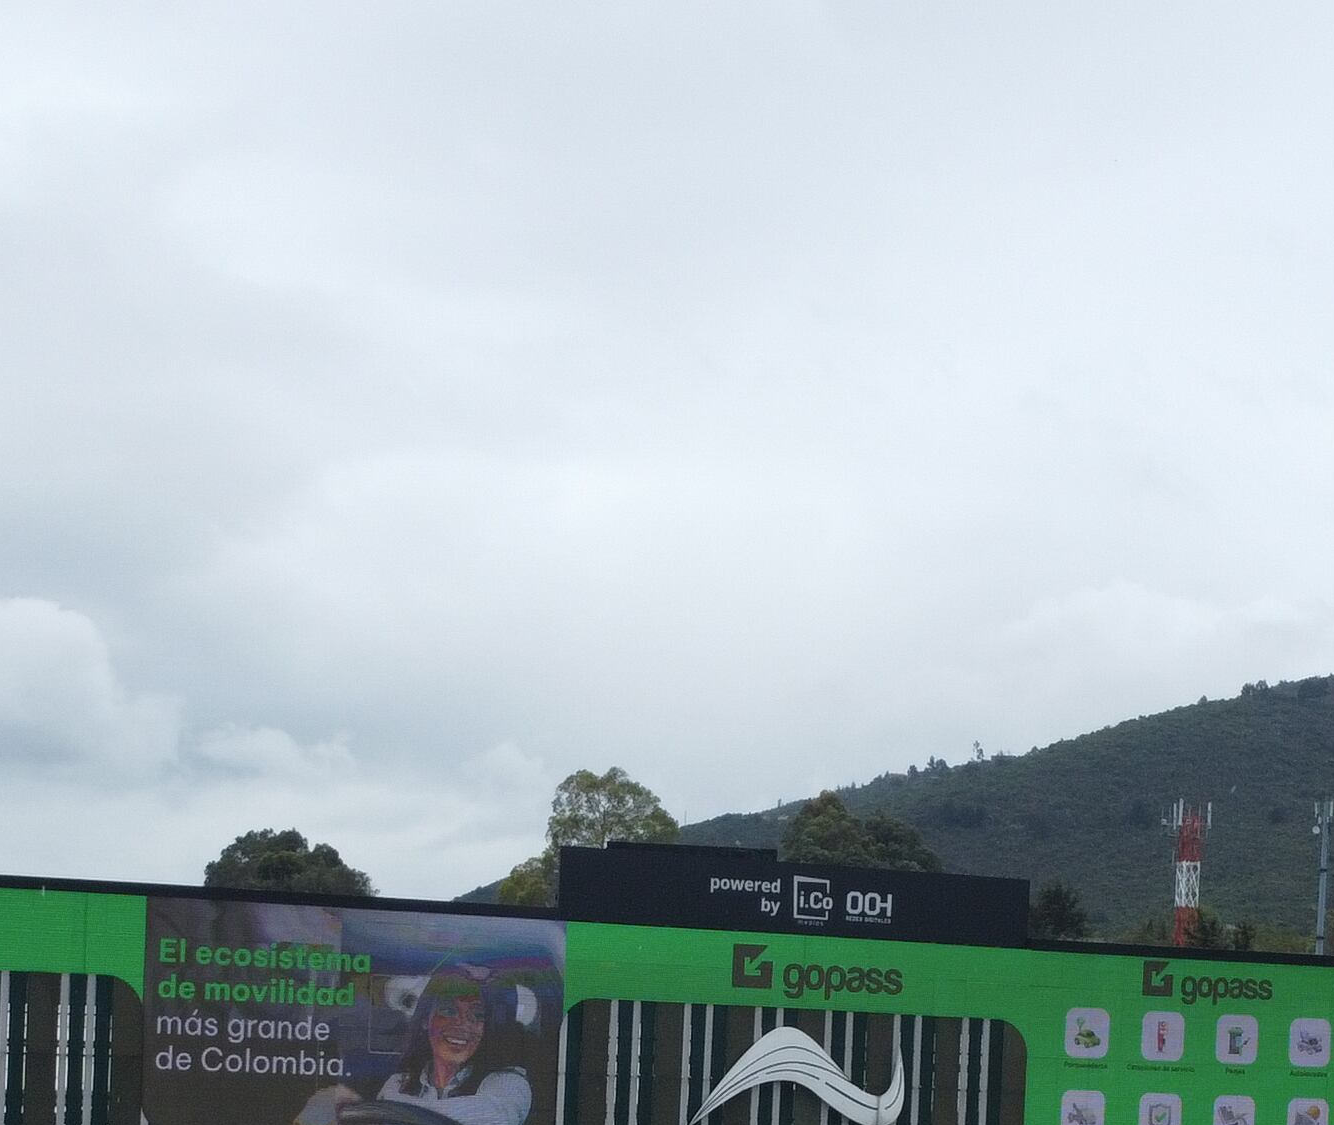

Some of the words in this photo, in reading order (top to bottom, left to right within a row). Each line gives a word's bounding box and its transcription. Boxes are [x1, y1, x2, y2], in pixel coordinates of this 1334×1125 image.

[710, 877, 781, 894] powered
[760, 898, 781, 917] by
[159, 938, 186, 964] El
[195, 941, 371, 975] ecosistema
[158, 973, 194, 999] de
[204, 976, 355, 1007] movilidad
[783, 960, 903, 999] gopass
[1180, 973, 1273, 1004] gopass
[156, 1009, 218, 1038] más
[227, 1014, 331, 1048] grande
[155, 1043, 192, 1071] de
[201, 1046, 353, 1078] Colombia.
